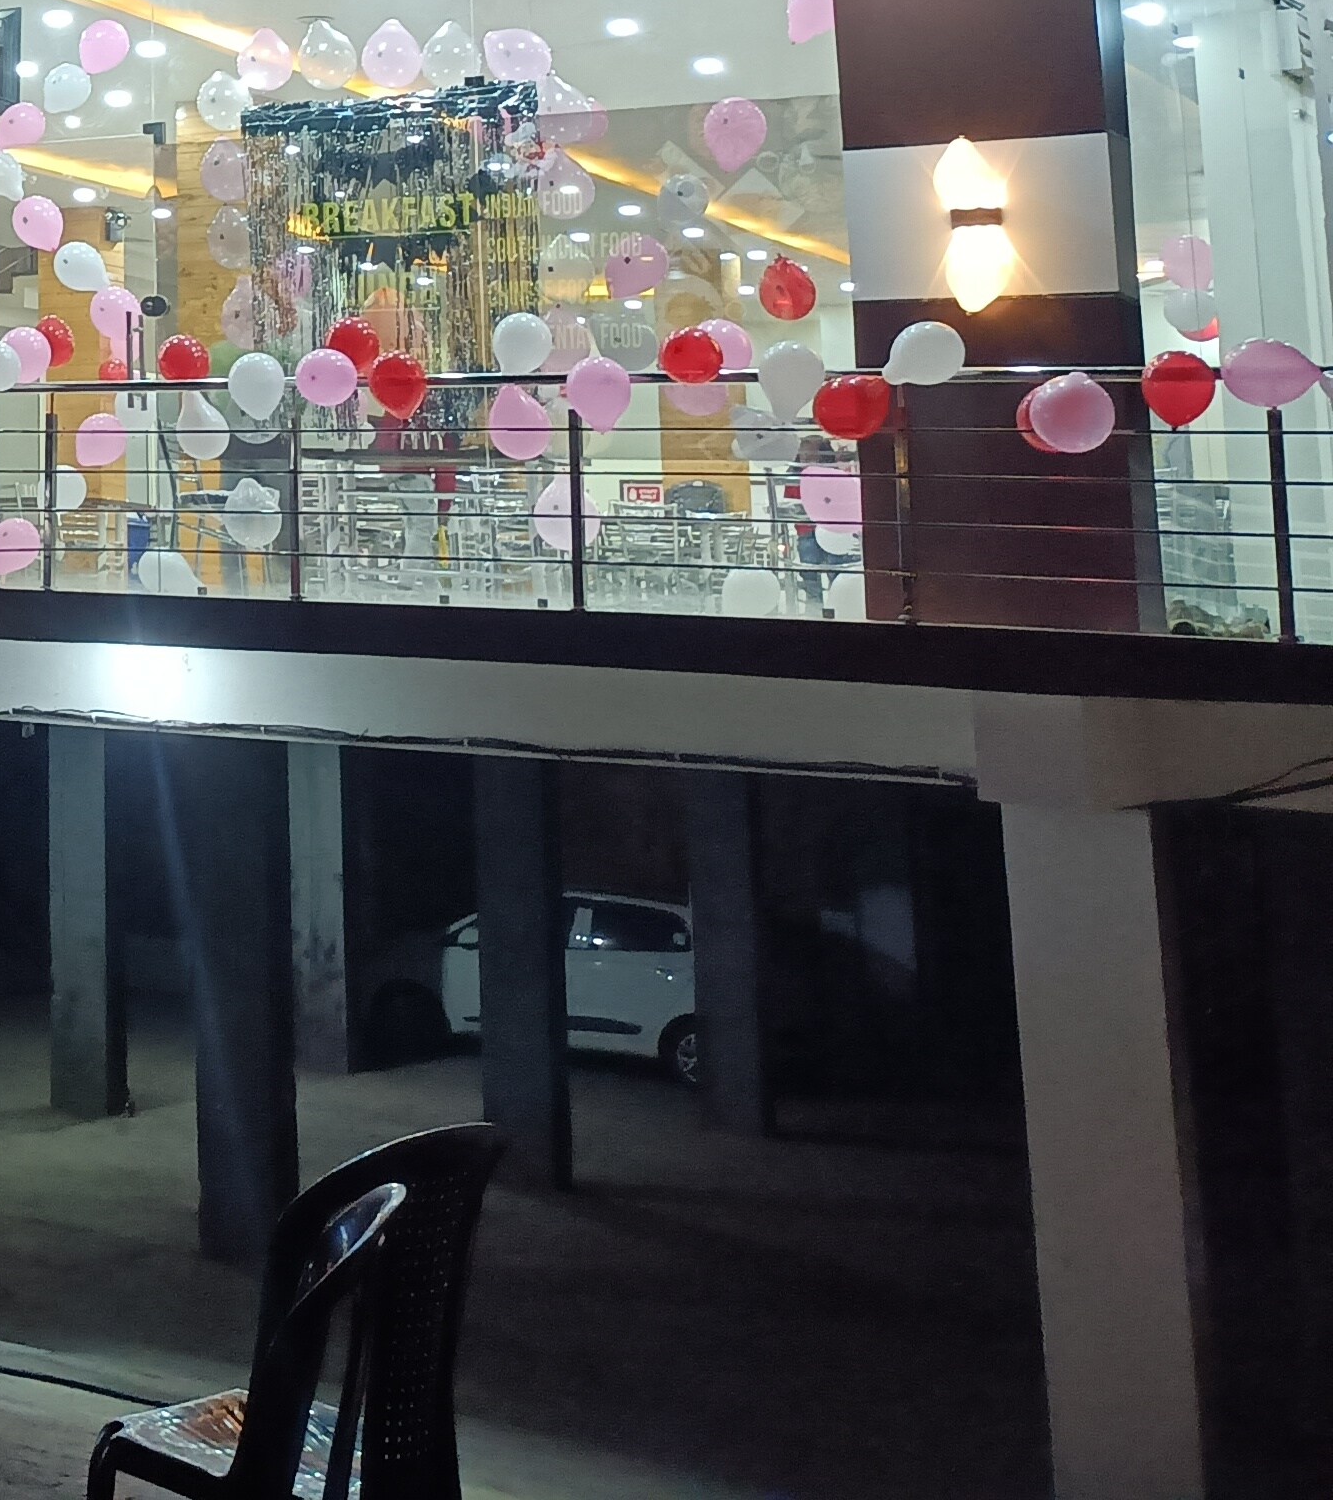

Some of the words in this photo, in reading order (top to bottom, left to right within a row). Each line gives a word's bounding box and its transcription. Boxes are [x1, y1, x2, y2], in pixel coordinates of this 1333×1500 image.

[301, 192, 475, 235] BREAKFAST
[543, 190, 582, 216] FOOD
[601, 231, 643, 258] FOOD
[600, 322, 643, 349] FOOD
